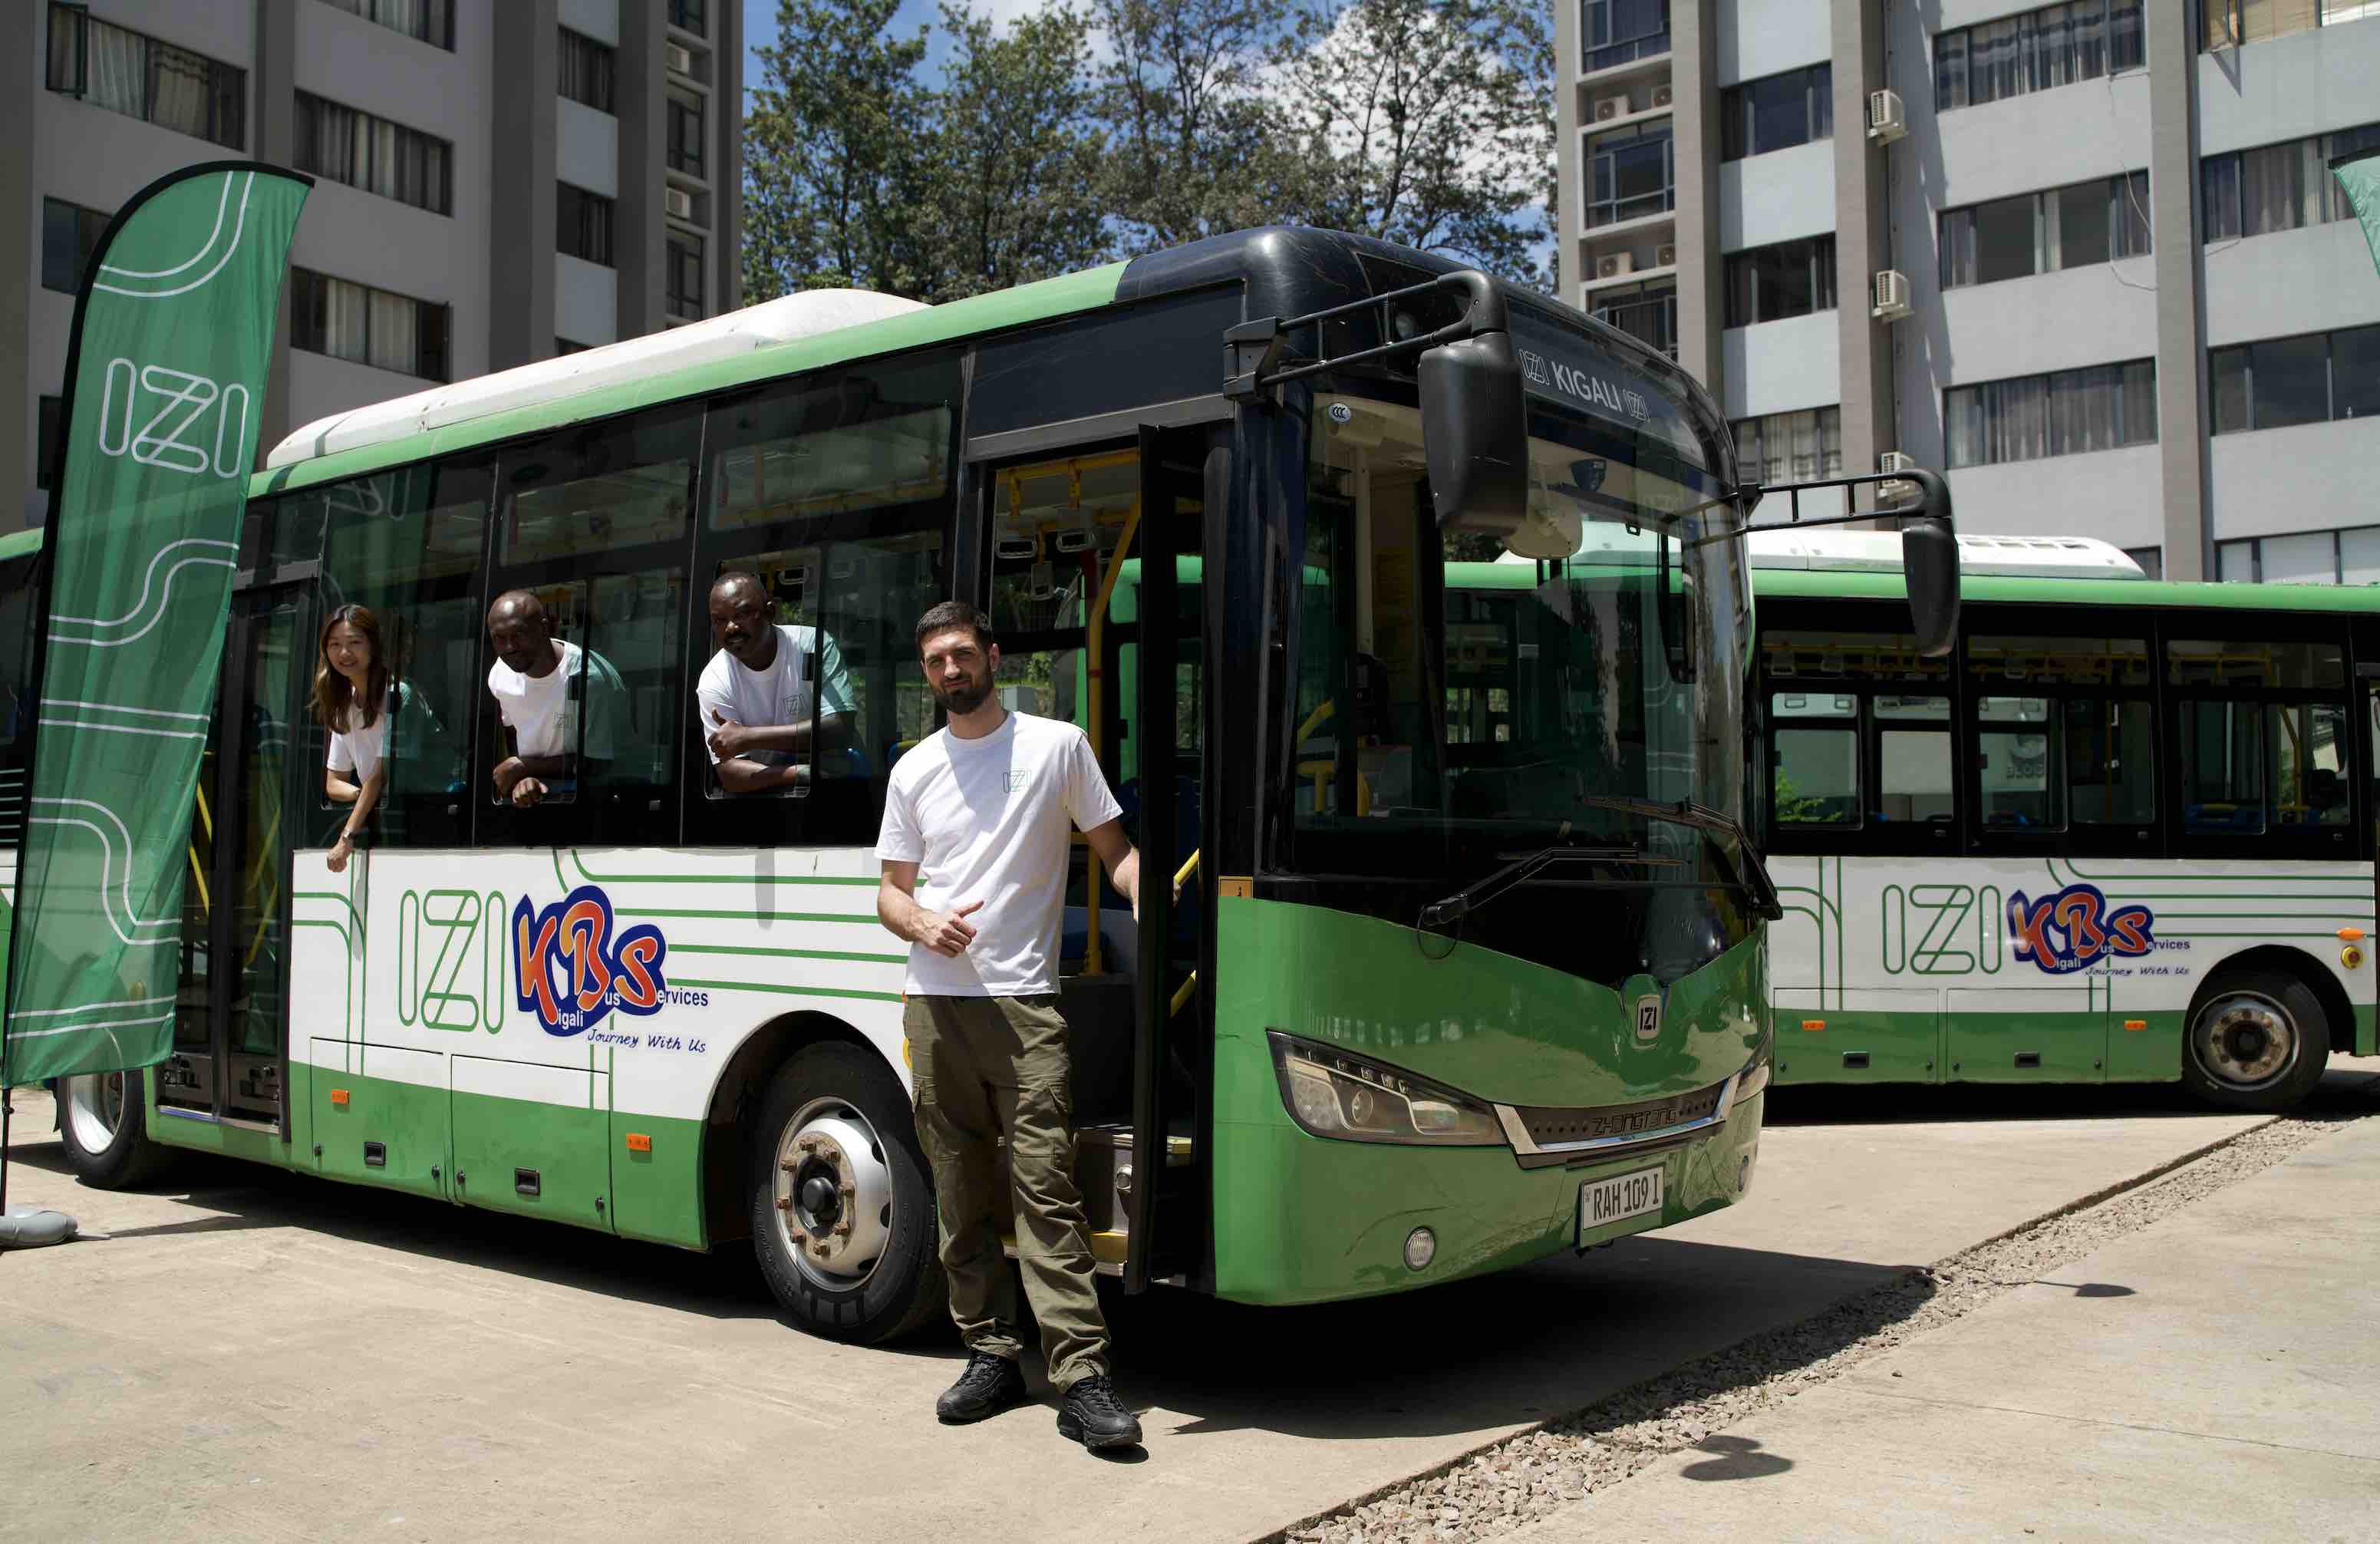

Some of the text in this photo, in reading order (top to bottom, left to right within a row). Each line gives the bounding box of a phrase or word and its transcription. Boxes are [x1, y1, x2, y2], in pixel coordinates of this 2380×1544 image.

[1551, 361, 1622, 412] KIGALI
[99, 358, 249, 479] IZI
[1882, 884, 2001, 975] IZI
[2013, 892, 2148, 968] KBS
[399, 889, 506, 1034] IZI
[518, 899, 658, 1025] KBS
[2139, 966, 2169, 976] With
[2175, 966, 2190, 975] Us
[588, 1028, 706, 1052] Journey With Us
[1640, 1006, 1656, 1031] IZI
[1594, 1182, 1620, 1221] RAH
[1624, 1176, 1649, 1212] 109
